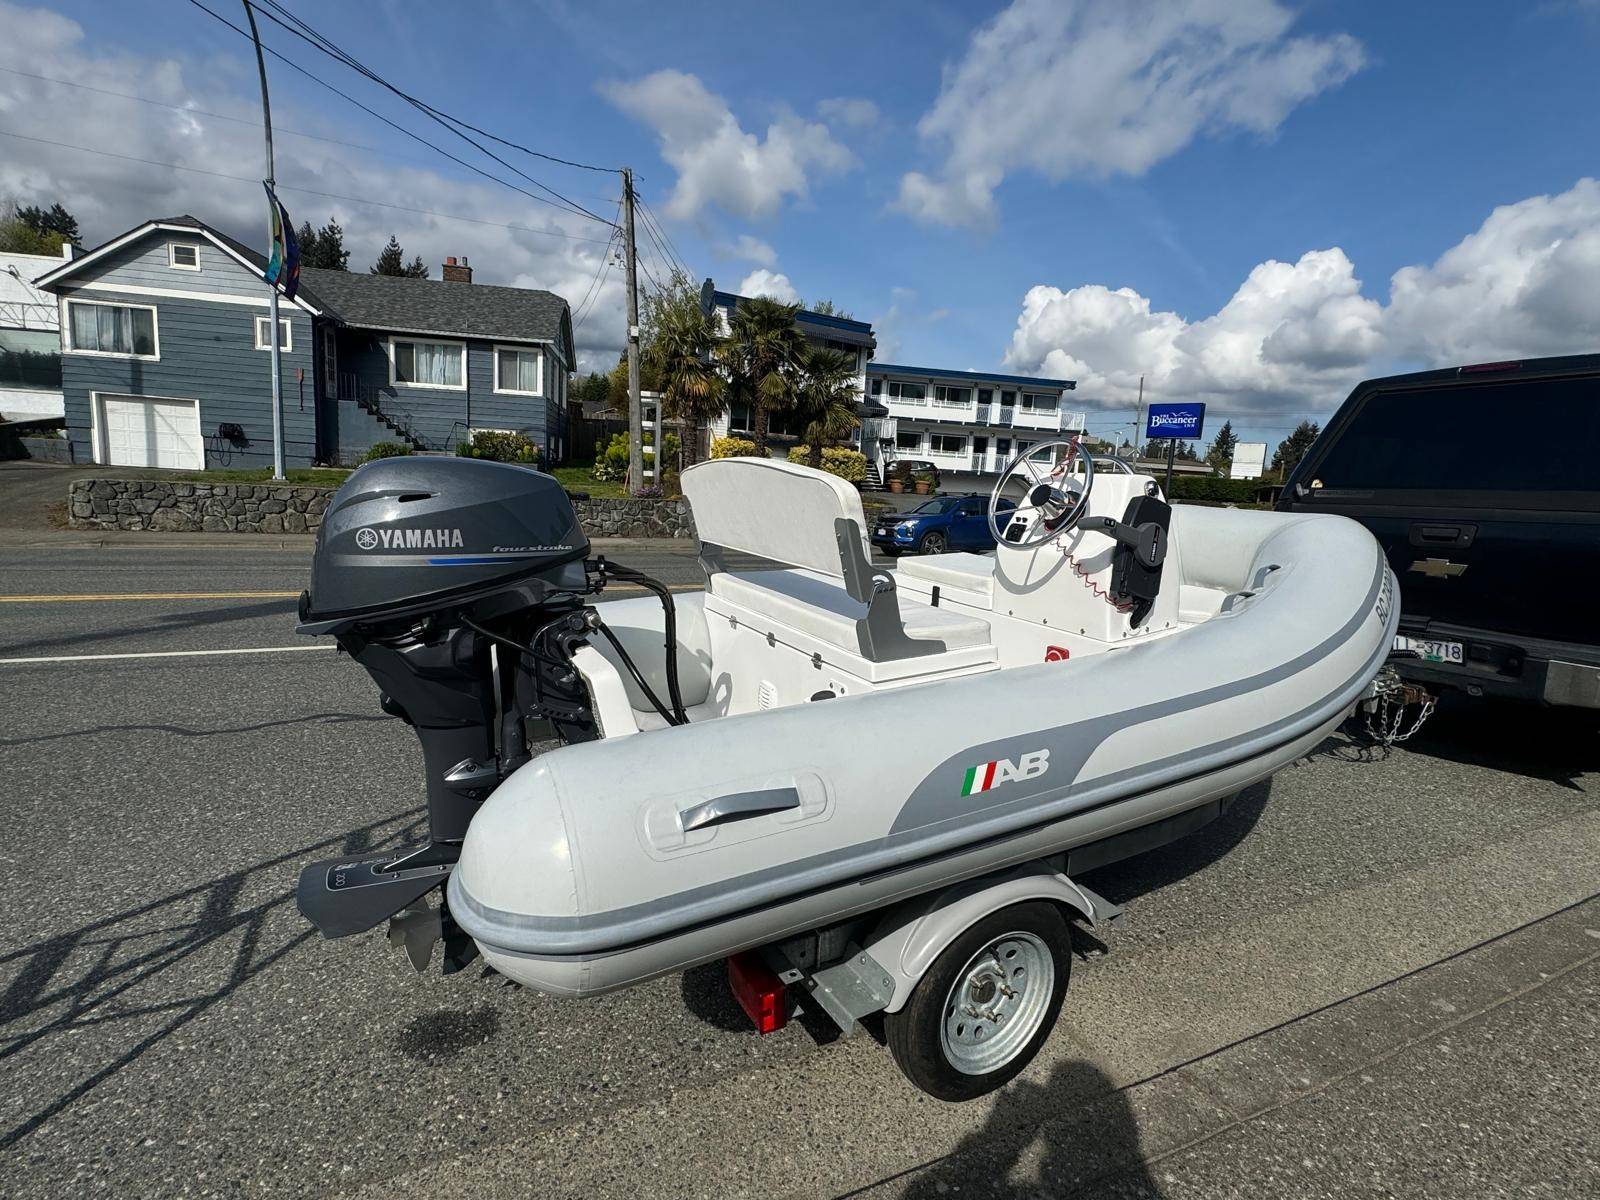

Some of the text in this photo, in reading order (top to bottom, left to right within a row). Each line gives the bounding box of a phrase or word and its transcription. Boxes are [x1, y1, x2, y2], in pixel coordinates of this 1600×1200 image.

[1151, 415, 1198, 428] Buccaneer
[379, 528, 464, 548] YAMAHA
[990, 748, 1050, 789] AB
